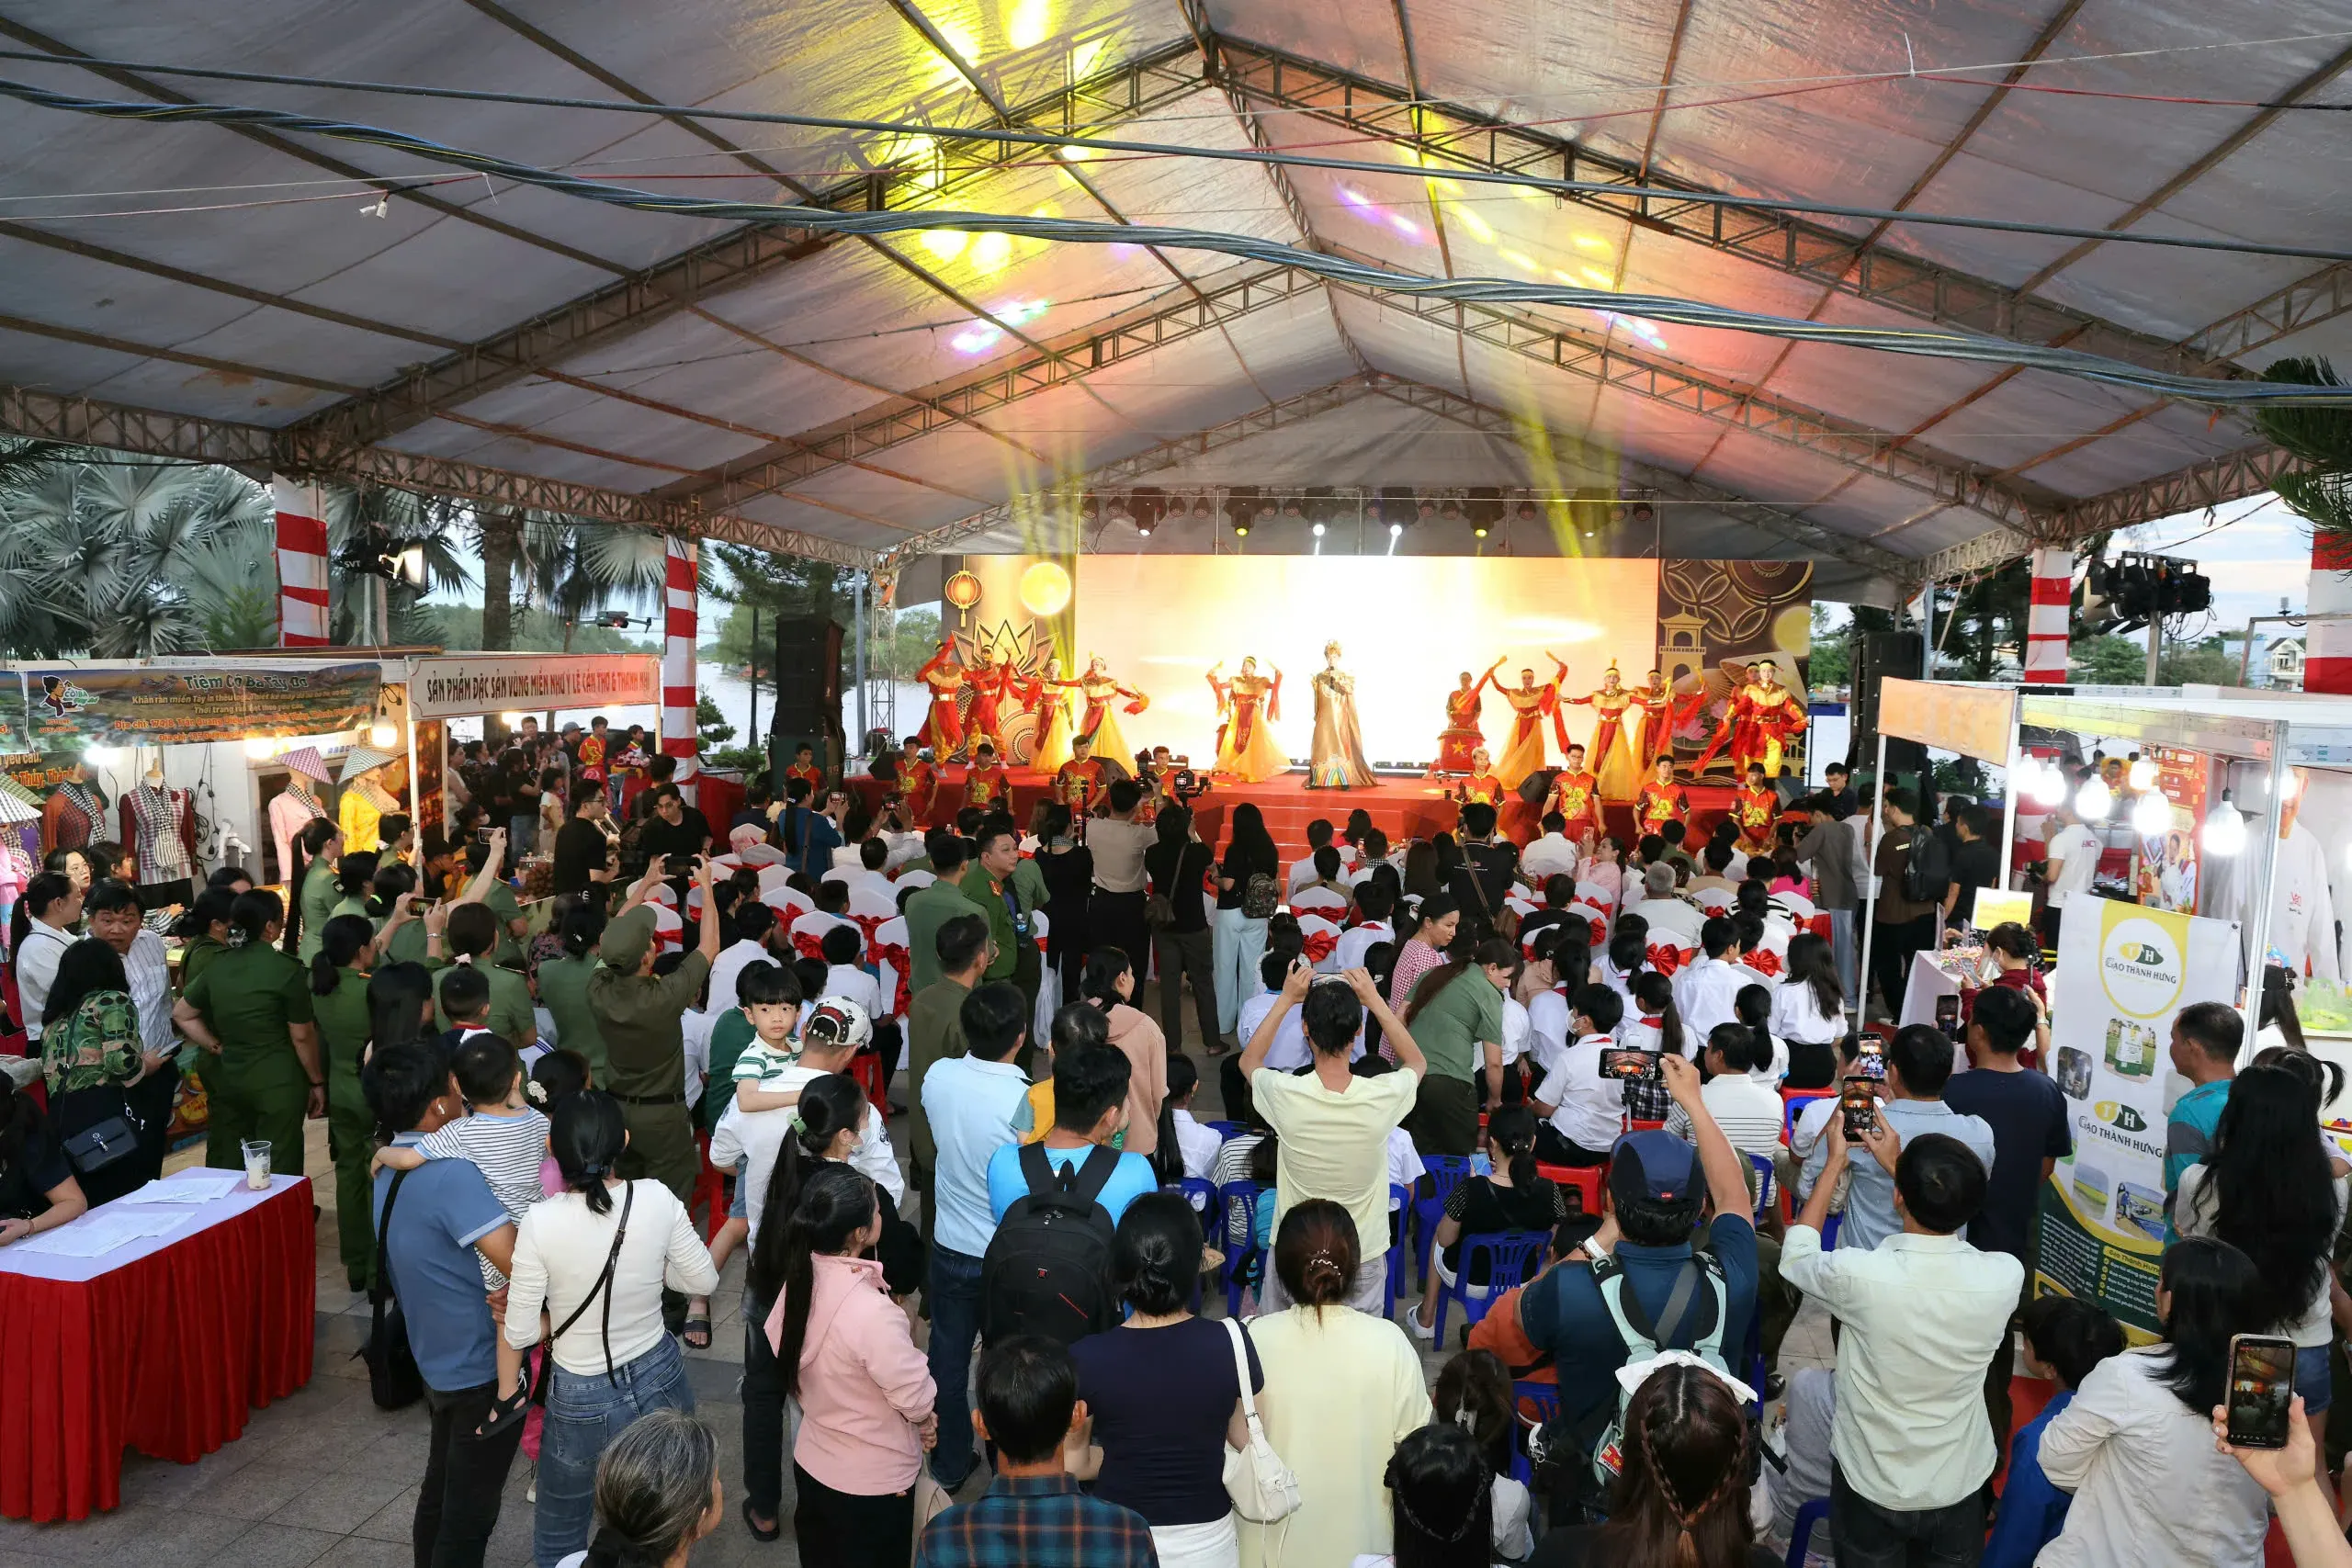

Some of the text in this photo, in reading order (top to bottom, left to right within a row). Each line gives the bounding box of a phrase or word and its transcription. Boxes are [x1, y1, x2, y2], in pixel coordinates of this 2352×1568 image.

[183, 674, 223, 693] Tiệm
[226, 673, 243, 688] Cô
[244, 675, 264, 688] Ba
[427, 670, 445, 705] SẢN
[447, 667, 470, 703] PHẨM
[473, 672, 489, 705] ĐẶC
[491, 669, 506, 700] SẢN
[508, 670, 529, 697] VÙNG
[132, 695, 153, 705] Khăn
[115, 720, 130, 731] Địa
[2126, 964, 2152, 978] THÀNH
[2153, 971, 2177, 985] HƯNG
[2099, 1127, 2132, 1147] THÀNH
[2132, 1139, 2163, 1158] HƯNG
